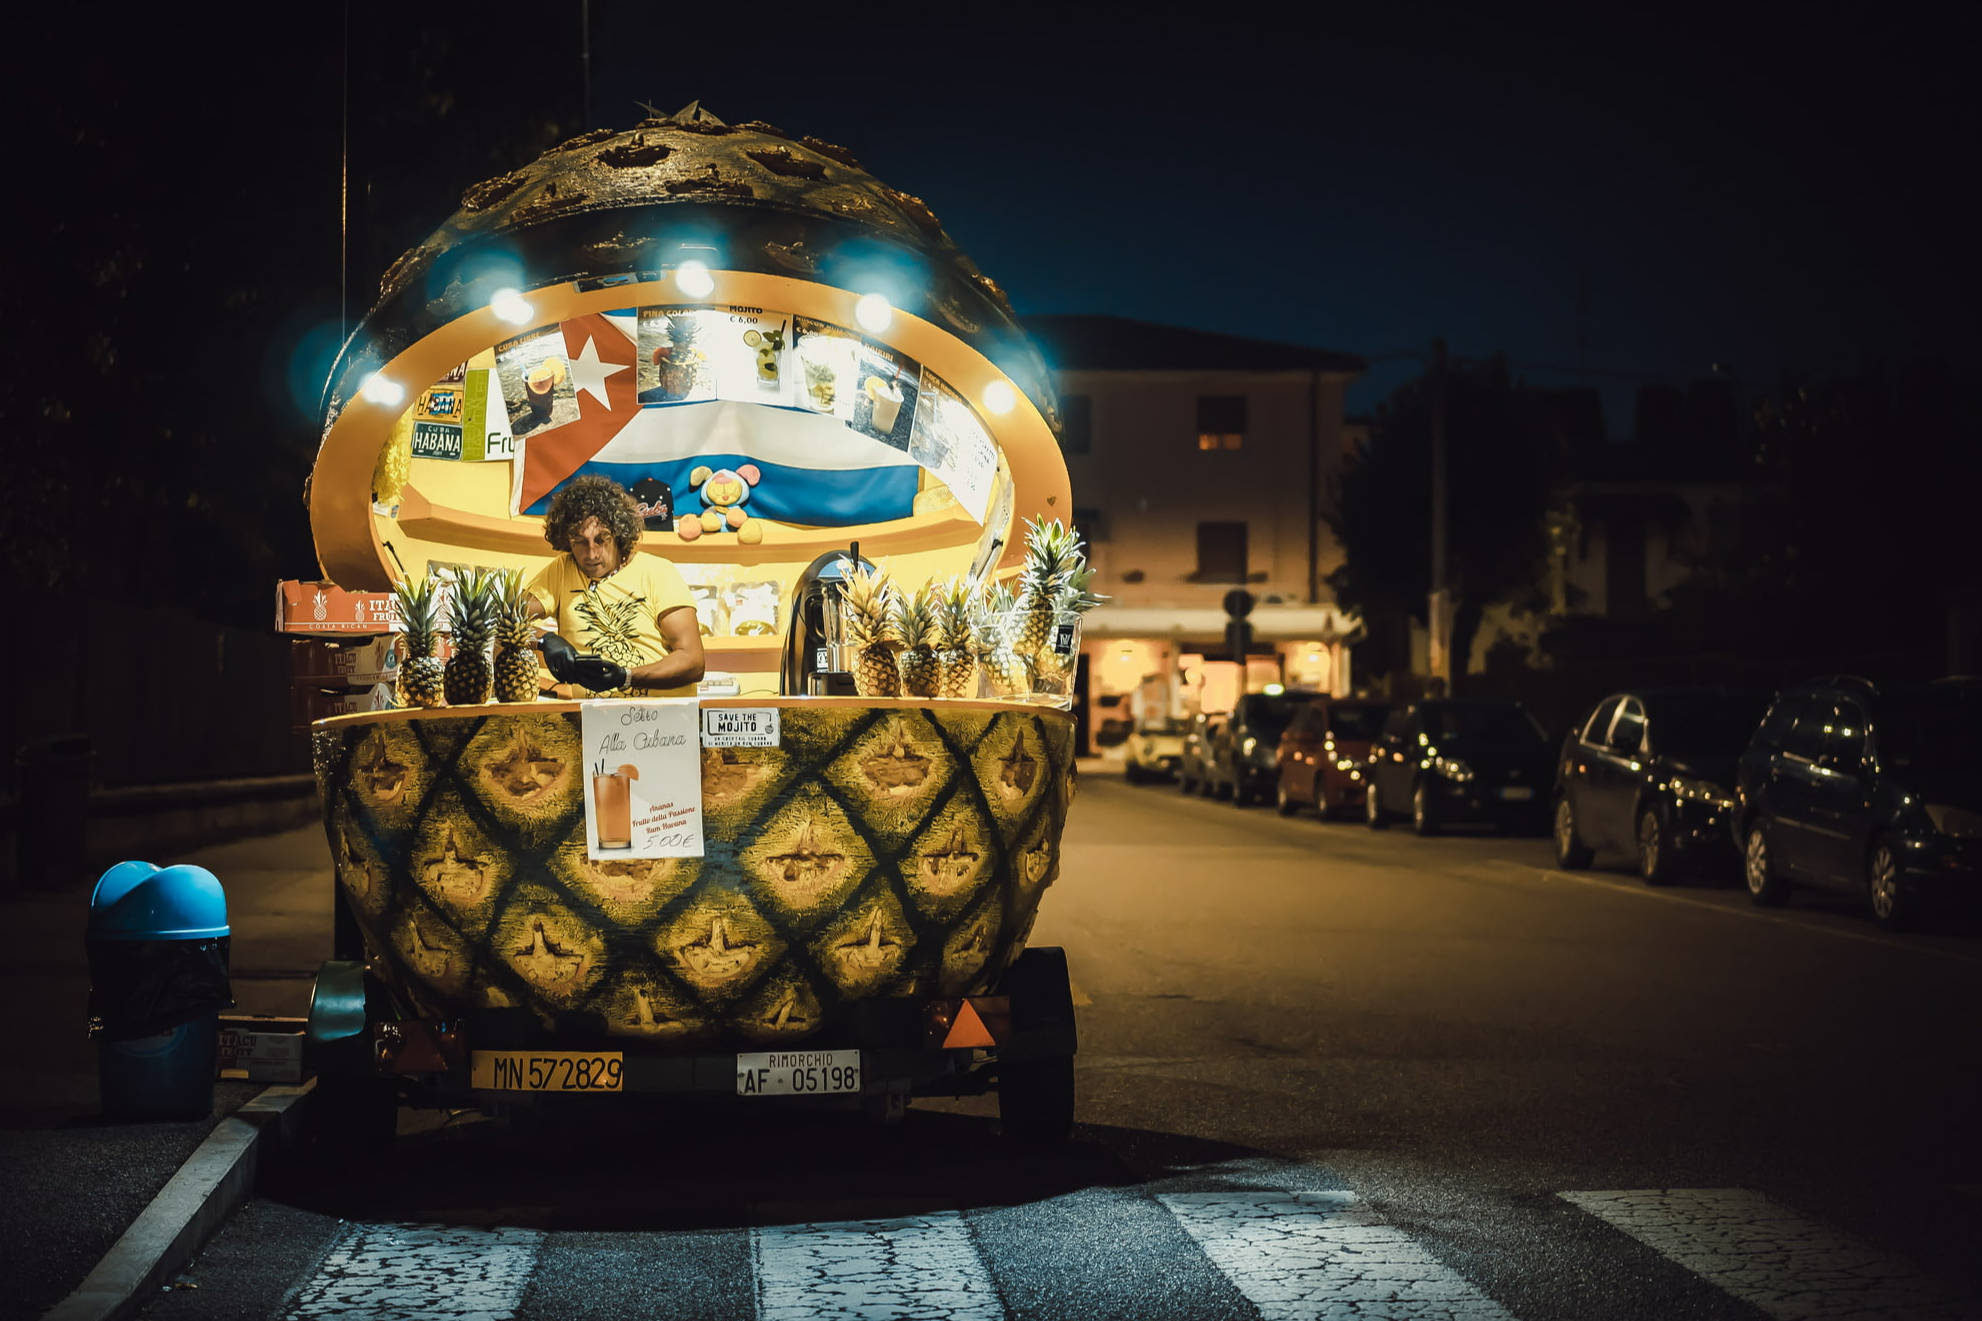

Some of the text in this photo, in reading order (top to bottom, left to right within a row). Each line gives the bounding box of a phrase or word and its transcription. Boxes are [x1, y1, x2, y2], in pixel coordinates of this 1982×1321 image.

[729, 305, 763, 314] MOJITO
[427, 425, 450, 433] CUBA
[413, 432, 460, 452] HABANA
[718, 713, 757, 721] SAVE THE
[718, 722, 757, 732] MOJITO
[599, 728, 686, 754] Alla Cubana
[769, 1053, 833, 1068] RIMORCHIO
[744, 1066, 855, 1093] AF 05198
